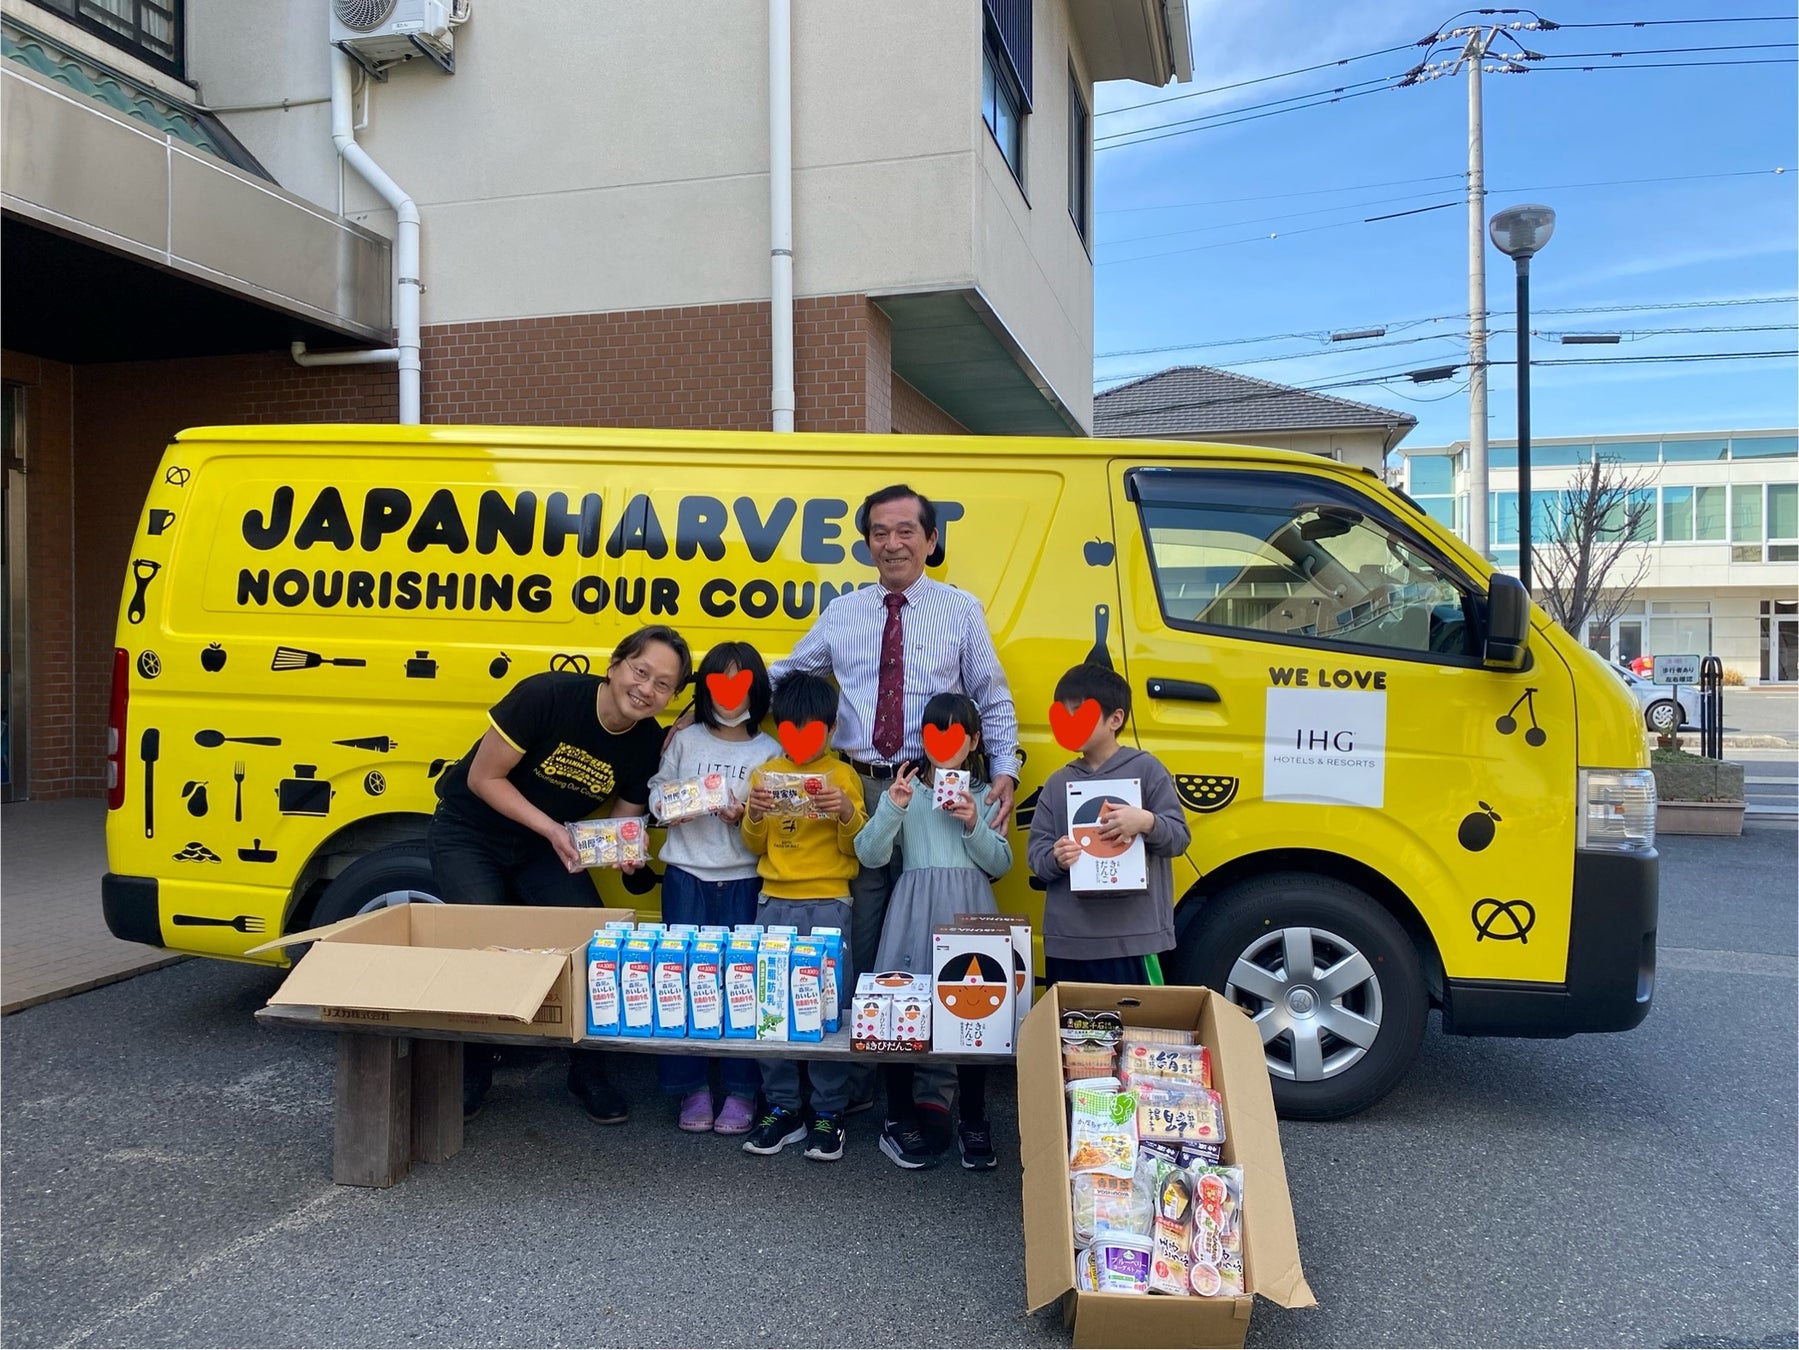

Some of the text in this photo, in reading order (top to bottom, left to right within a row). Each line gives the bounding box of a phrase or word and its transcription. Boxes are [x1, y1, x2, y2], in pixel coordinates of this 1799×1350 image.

[237, 568, 552, 614] NOURISHING
[572, 575, 680, 616] OUR
[1269, 667, 1387, 690] WE LOVE
[1296, 729, 1354, 752] IHG
[1273, 756, 1315, 765] HOTELS
[1327, 759, 1375, 768] RESORTS
[697, 763, 747, 780] LITTLE
[568, 783, 580, 792] Our
[767, 957, 776, 1006] 無脂肪乳
[592, 986, 615, 994] おいしい
[625, 987, 648, 995] おいしい
[693, 989, 716, 997] おいしい
[730, 989, 753, 997] おいしい
[795, 992, 818, 1000] おいしい
[1156, 1051, 1179, 1072] 絹
[1112, 1257, 1147, 1268] ブルーベリー
